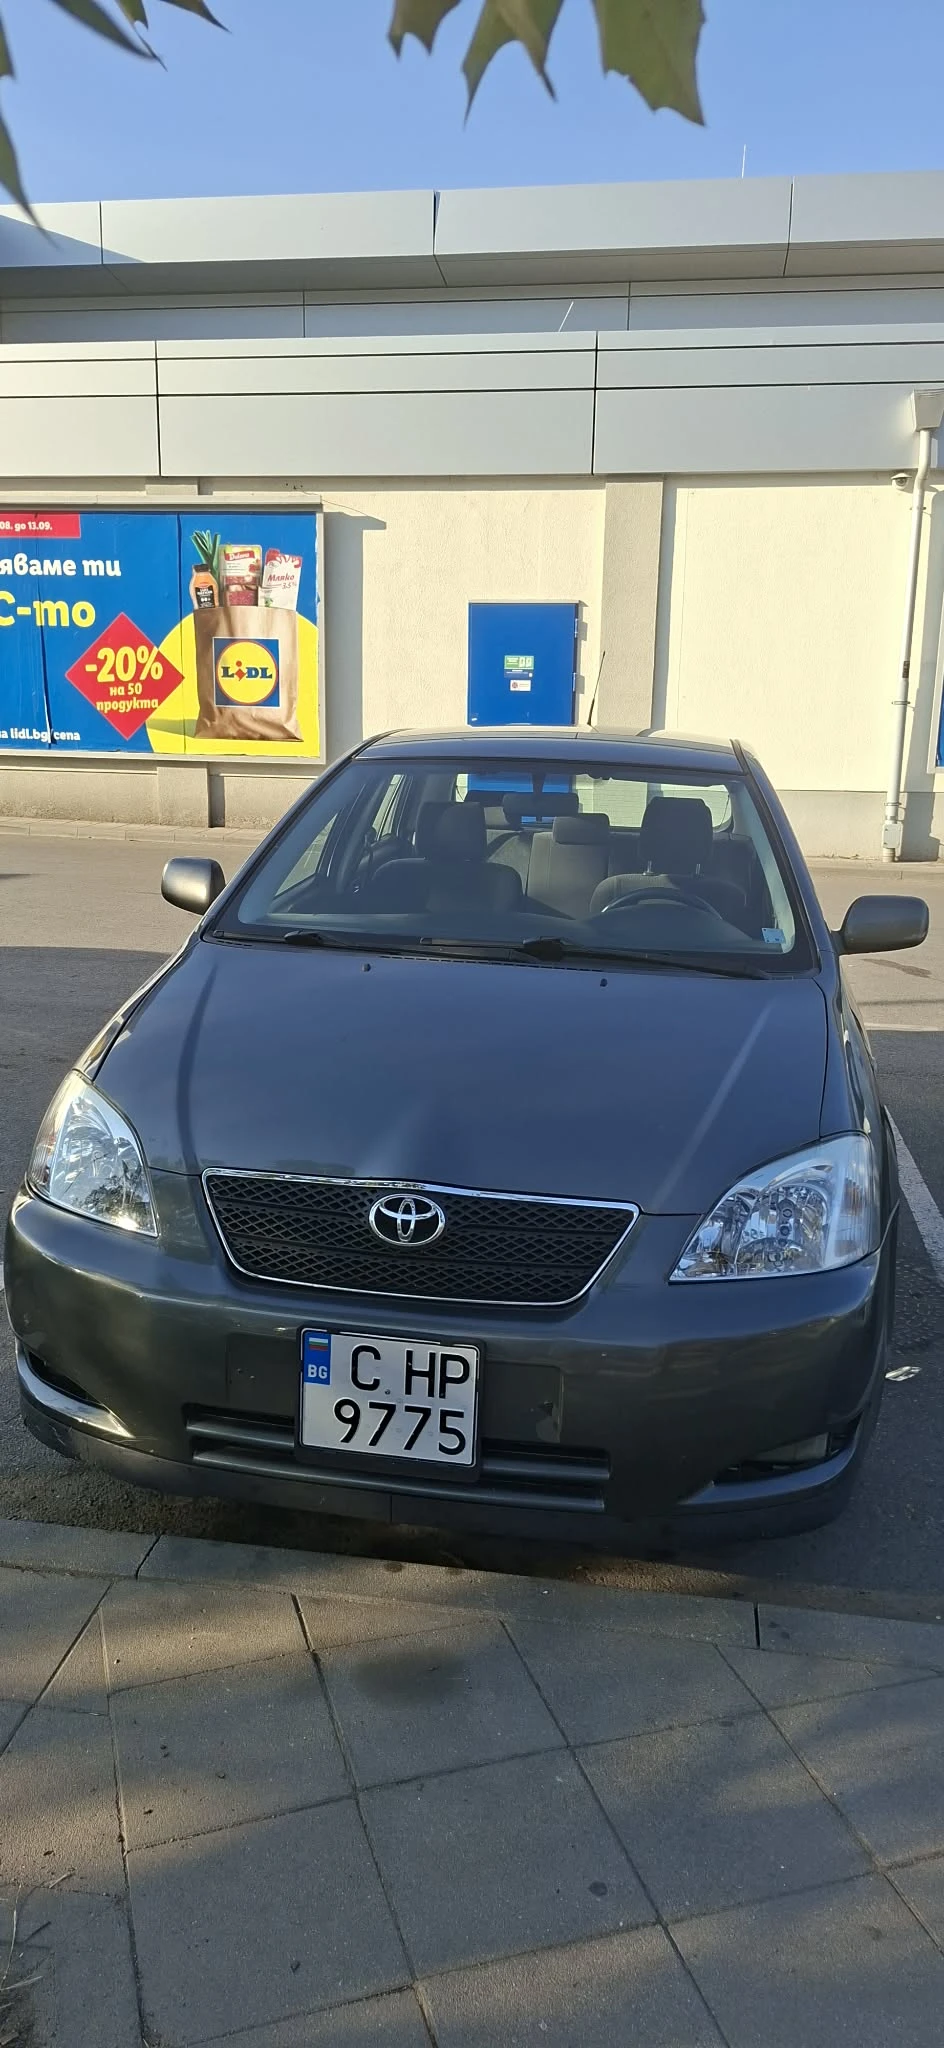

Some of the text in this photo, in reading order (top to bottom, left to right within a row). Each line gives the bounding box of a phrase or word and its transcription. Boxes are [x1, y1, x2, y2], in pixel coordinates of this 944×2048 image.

[27, 521, 53, 531] 13.09.
[82, 559, 121, 576] ти
[85, 645, 164, 683] -20%
[109, 682, 143, 697] на 50
[307, 1363, 328, 1380] BG
[404, 1349, 470, 1399] HP
[333, 1398, 466, 1456] 9775
